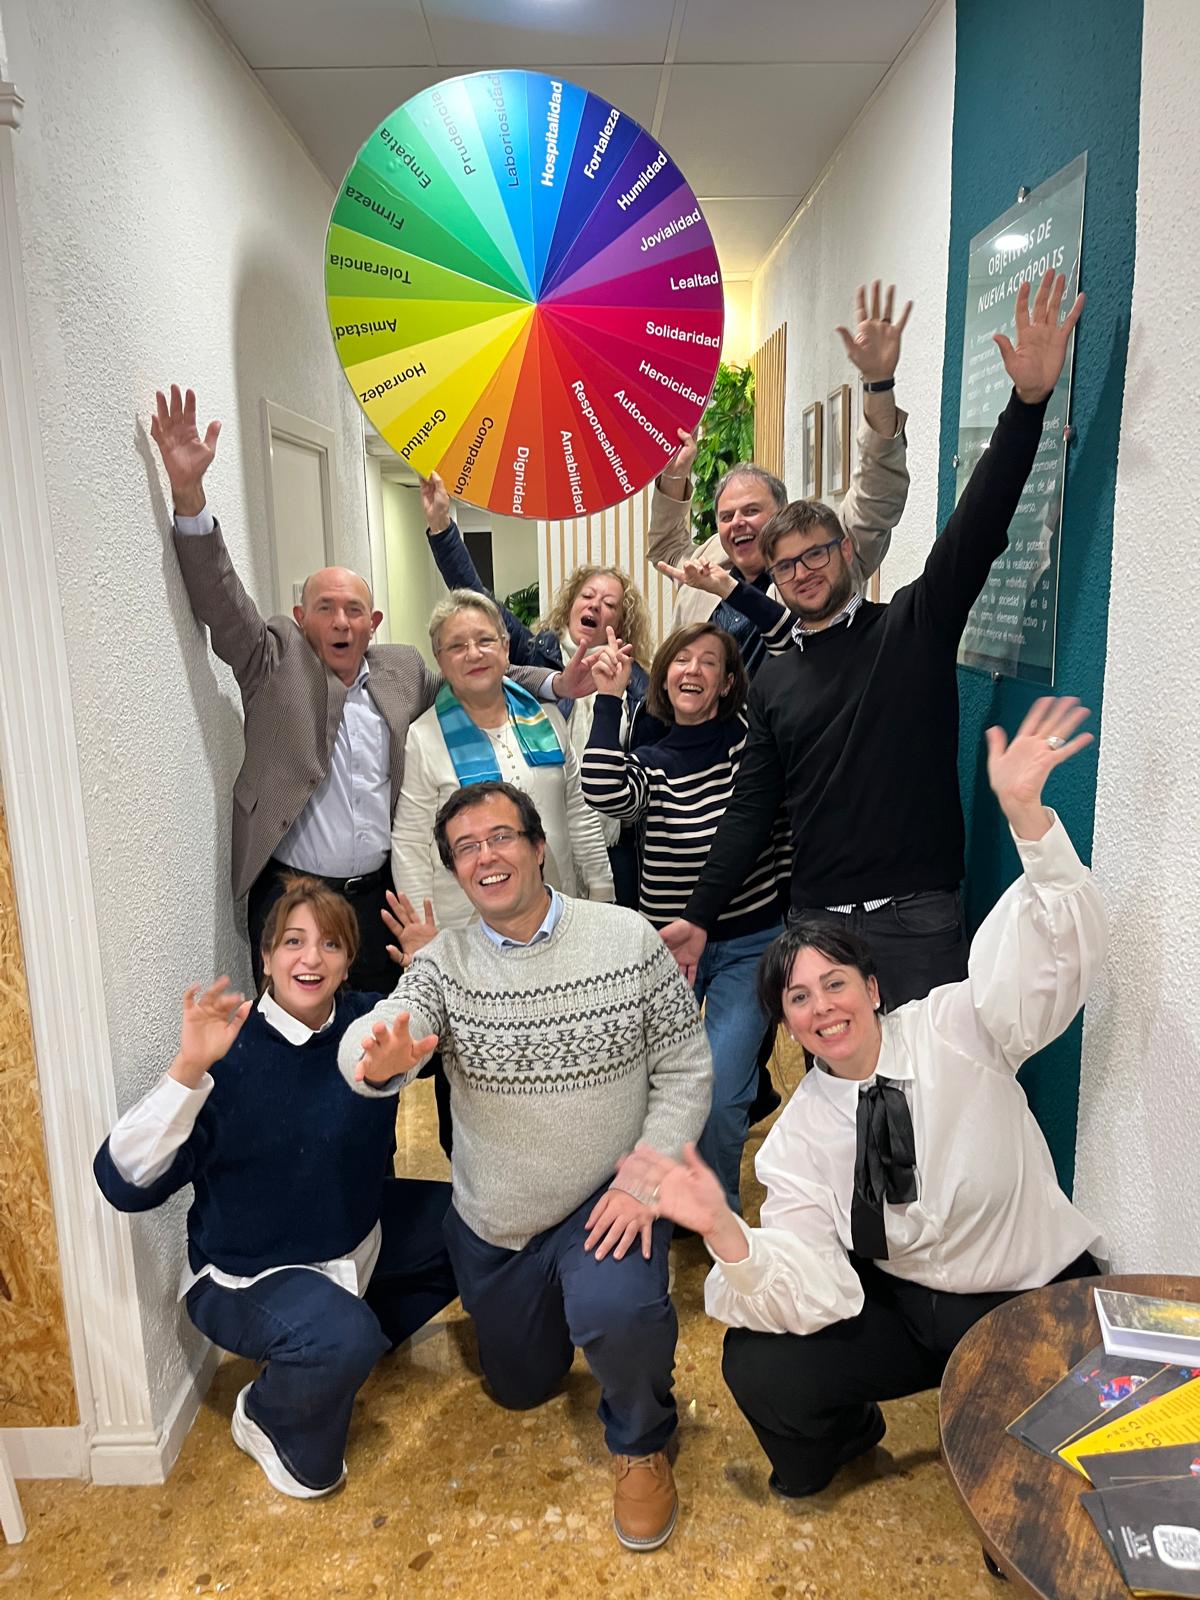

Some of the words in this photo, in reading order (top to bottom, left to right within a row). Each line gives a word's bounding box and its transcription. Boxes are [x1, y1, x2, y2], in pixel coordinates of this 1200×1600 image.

[431, 91, 476, 176] Prudencia
[489, 74, 519, 189] Laboriosidad
[540, 81, 563, 188] Hospitalidad
[583, 107, 620, 180] Fortaleza
[379, 127, 431, 190] Empatía
[616, 150, 669, 212] Humildad
[345, 185, 404, 230] Firmeza
[638, 208, 702, 252] Jovialidad
[1036, 217, 1053, 244] DE
[330, 253, 411, 285] Tolerancia
[669, 270, 719, 291] Lealtad
[977, 281, 1006, 314] NUEVA
[1006, 245, 1065, 297] ACRÓPOLIS
[335, 317, 398, 341] Amistad
[645, 320, 720, 348] Solidaridad
[359, 361, 427, 404] Honradez
[637, 359, 706, 407] Heroicidad
[400, 408, 447, 461] Gratitud
[570, 379, 635, 495] Responsabilidad
[613, 389, 676, 457] Autocontrol
[1042, 415, 1060, 431] ravés
[453, 416, 494, 496] Compasión
[512, 446, 530, 515] Dignidad
[559, 430, 586, 514] Amabilidad
[1042, 581, 1050, 590] su
[1042, 597, 1048, 610] la
[1042, 619, 1047, 632] y
